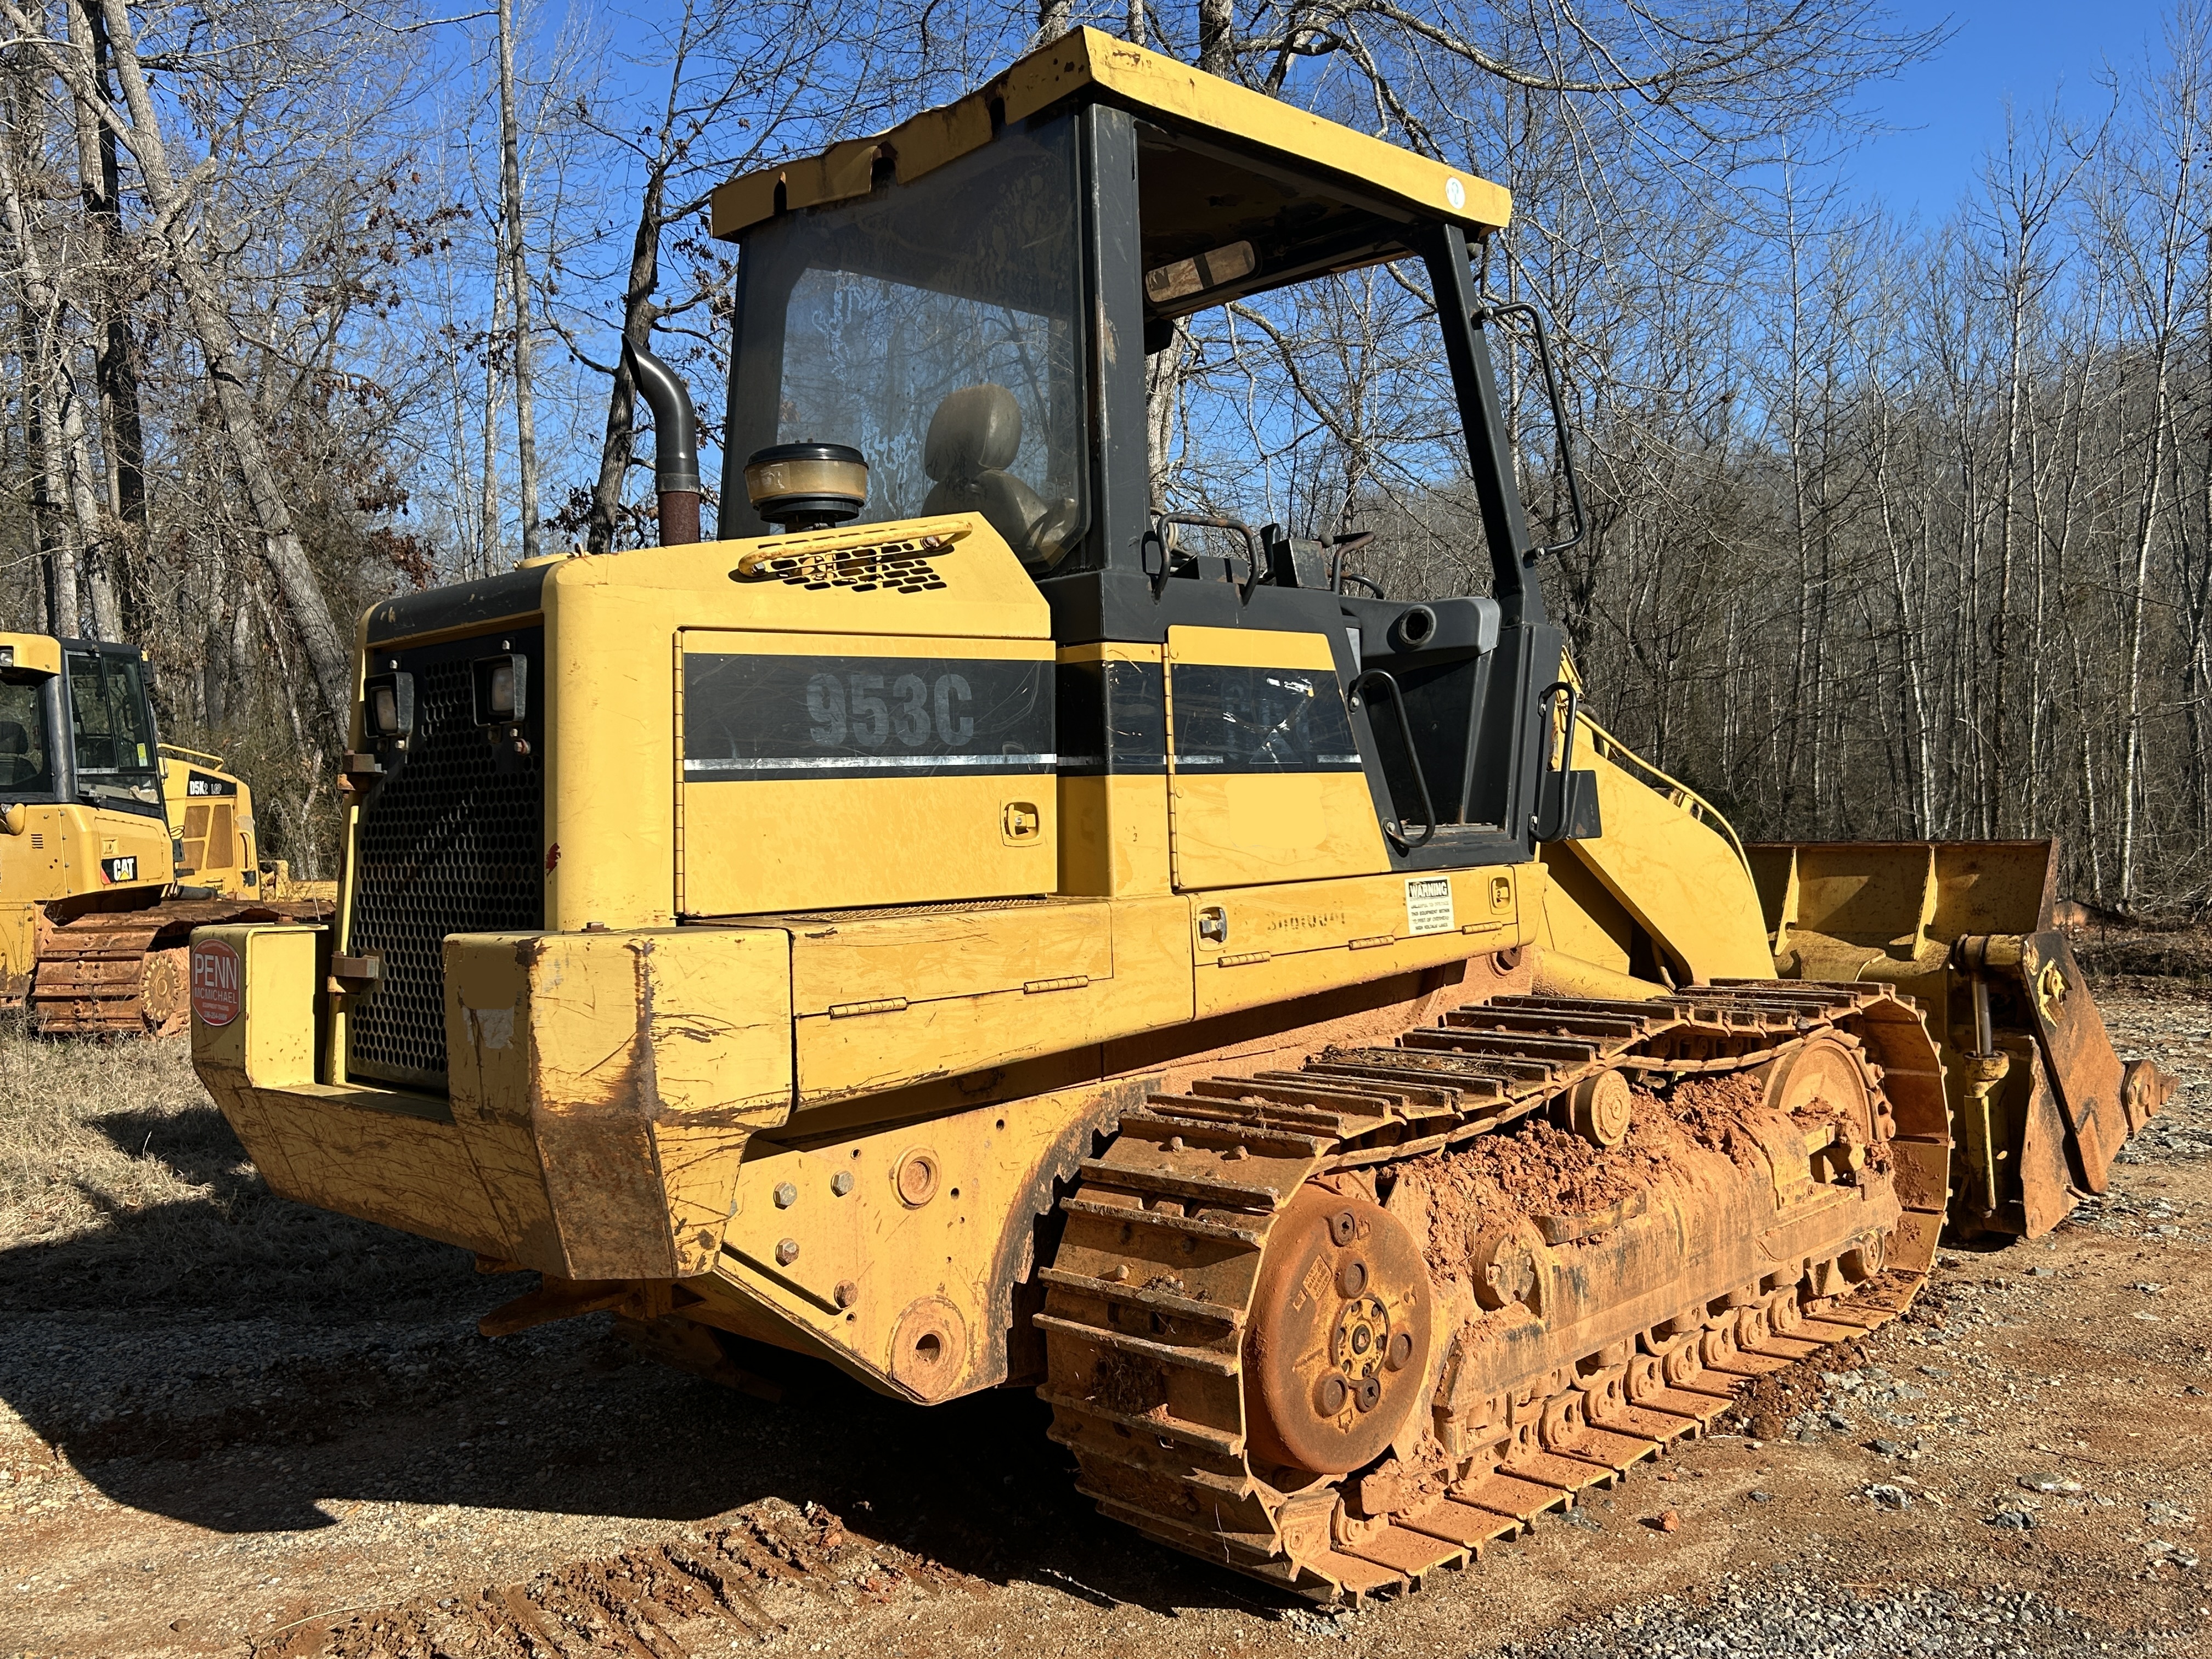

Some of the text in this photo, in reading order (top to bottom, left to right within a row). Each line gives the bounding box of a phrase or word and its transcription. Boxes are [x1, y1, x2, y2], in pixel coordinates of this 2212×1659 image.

[806, 673, 974, 747] 953C
[114, 858, 134, 881] CAT
[1409, 882, 1447, 898] WARNING
[194, 953, 237, 990] PENN
[194, 988, 238, 1004] MCMICHAEL
